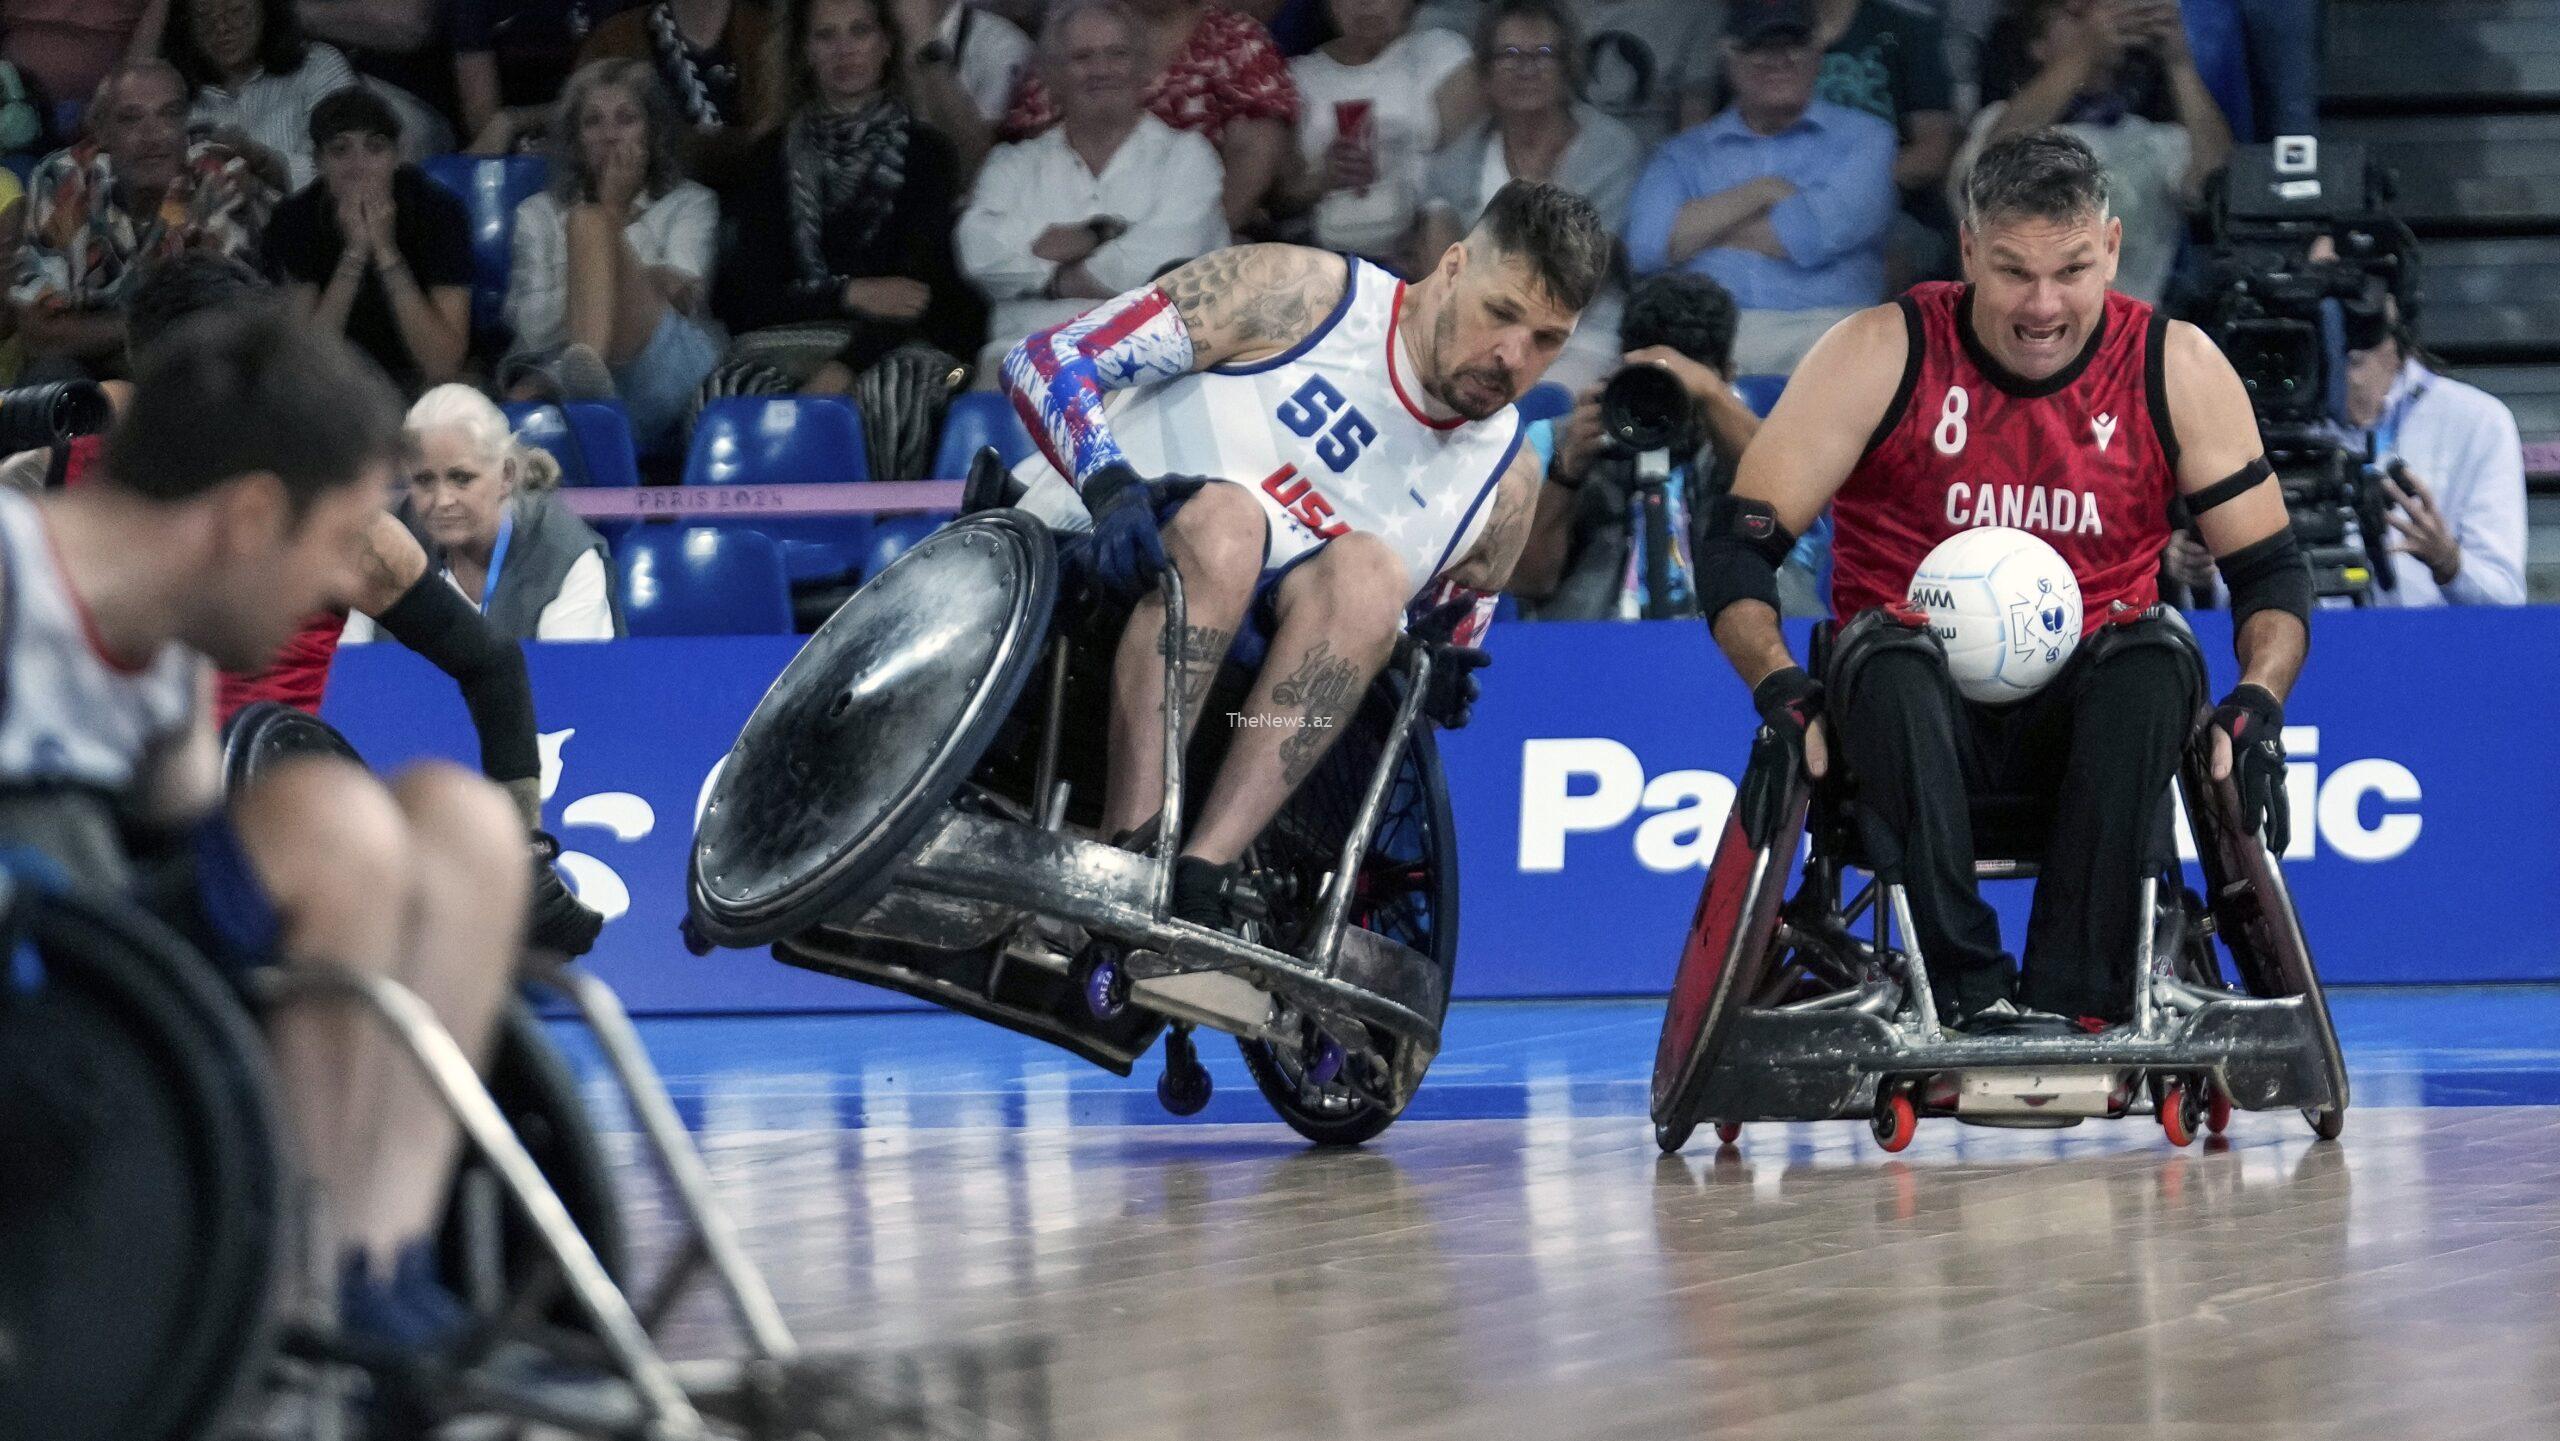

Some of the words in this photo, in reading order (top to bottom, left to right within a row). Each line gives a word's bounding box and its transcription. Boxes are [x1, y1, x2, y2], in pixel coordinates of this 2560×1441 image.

[1276, 373, 1378, 473] 55
[1934, 385, 1969, 454] 8
[635, 491, 709, 508] PARIS
[1946, 481, 2103, 535] CANADA
